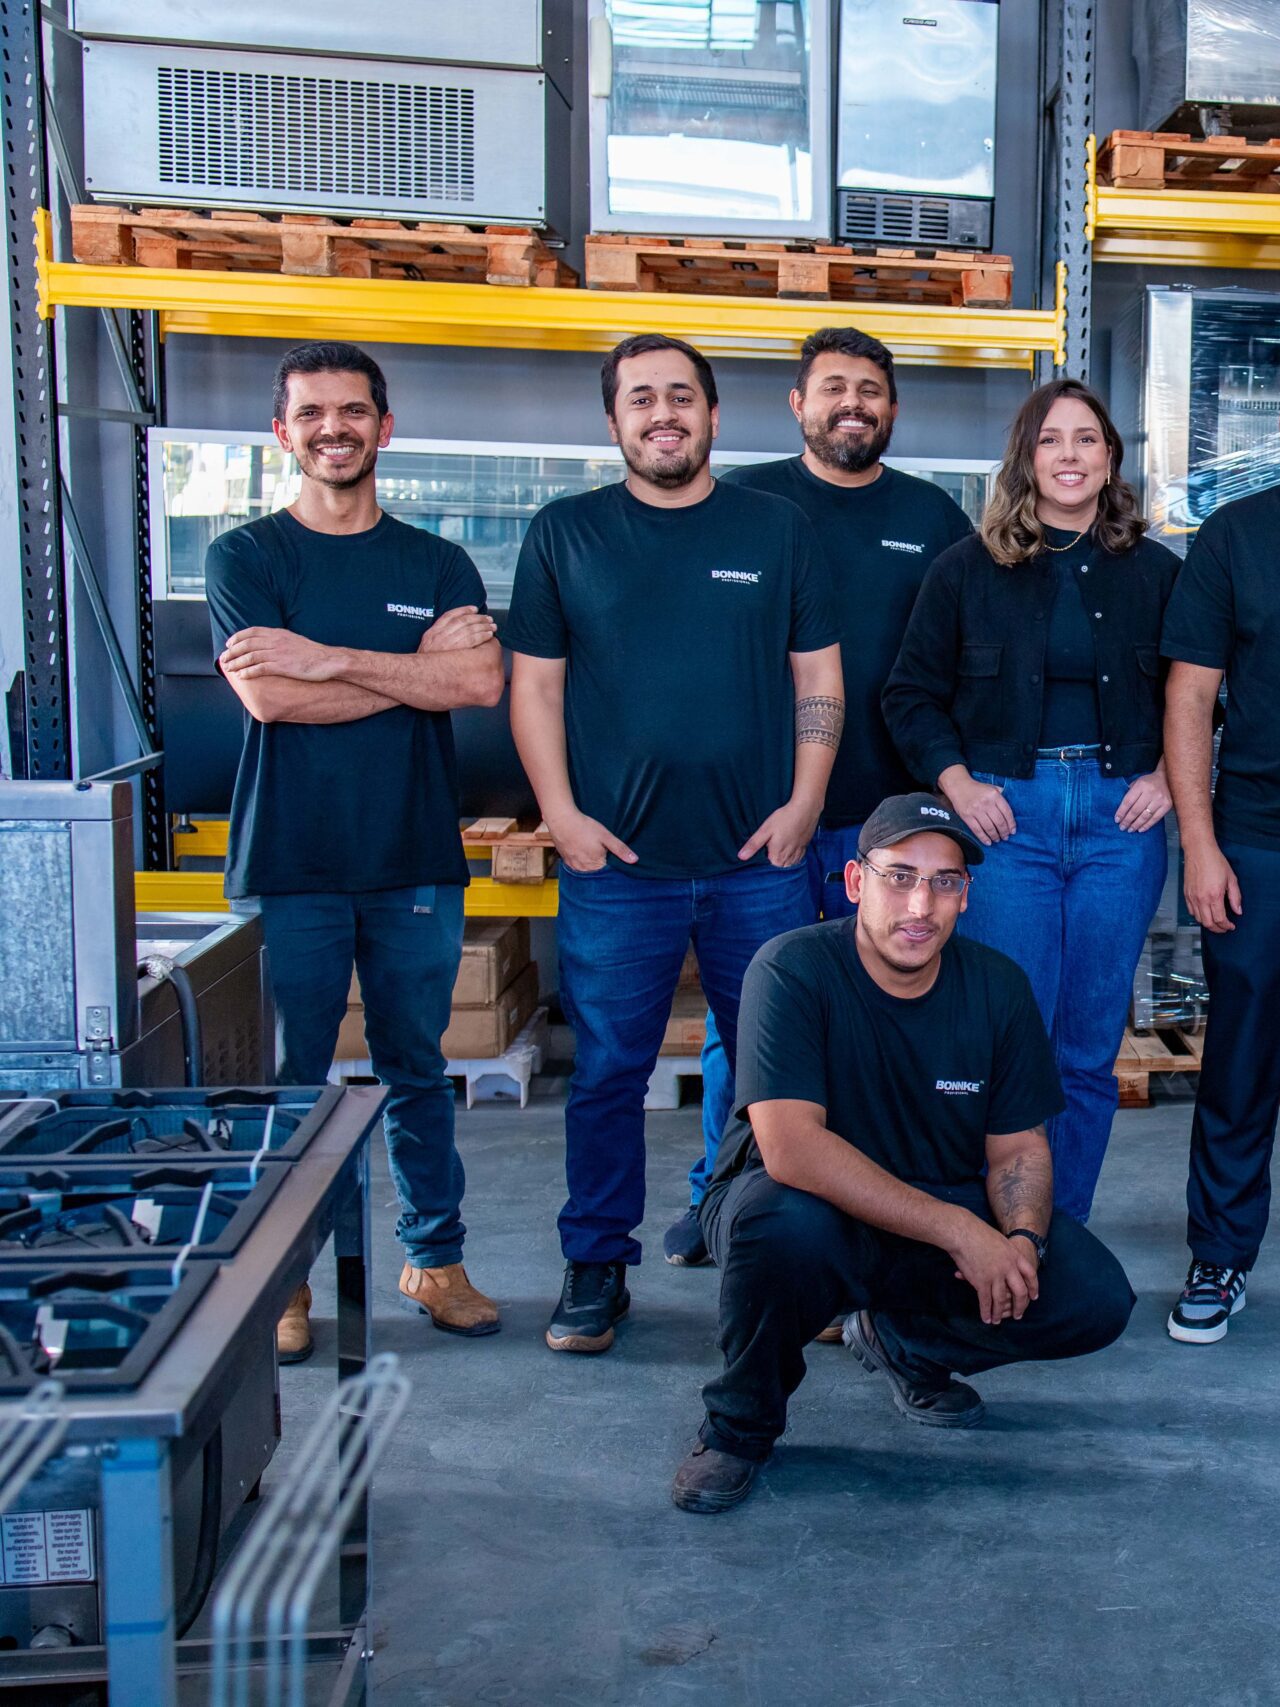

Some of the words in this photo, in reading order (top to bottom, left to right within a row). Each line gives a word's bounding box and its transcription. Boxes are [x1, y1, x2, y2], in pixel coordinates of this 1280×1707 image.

[882, 540, 922, 552] BONNKE
[712, 570, 758, 582] BONNKE
[387, 603, 434, 617] BONNKE
[920, 806, 950, 820] BOSS
[936, 1080, 980, 1092] BONNKE
